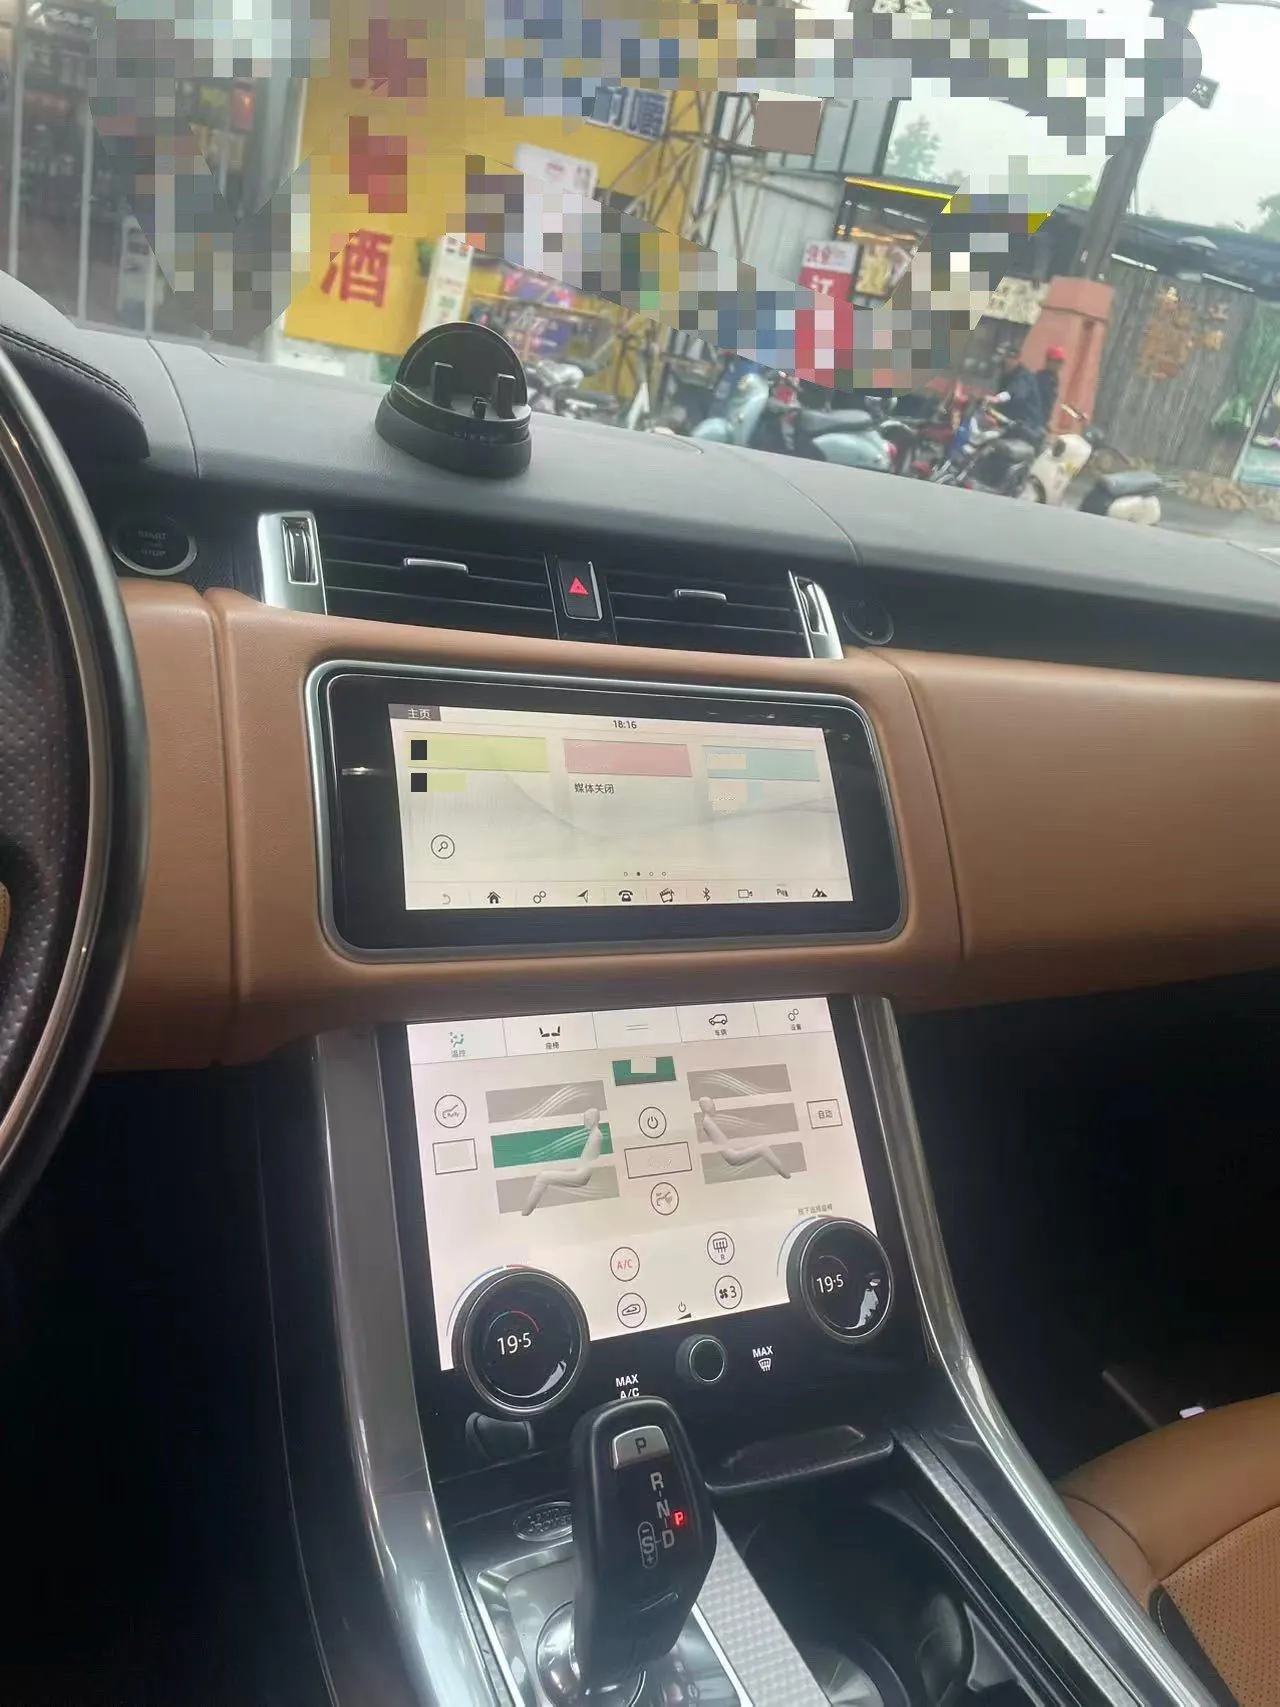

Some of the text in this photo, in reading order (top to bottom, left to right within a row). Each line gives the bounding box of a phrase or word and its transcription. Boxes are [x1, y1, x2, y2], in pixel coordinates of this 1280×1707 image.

[320, 229, 393, 308] 酒
[407, 707, 432, 720] 主页
[613, 720, 637, 729] 18:16
[574, 782, 615, 794] 媒体关闭
[818, 1109, 833, 1119] 自动
[616, 1259, 633, 1270] A/C
[729, 1285, 737, 1299] 3
[752, 1345, 774, 1358] MAX
[615, 1374, 639, 1387] MAX
[620, 1388, 640, 1400] A/C
[635, 1436, 647, 1454] P
[650, 1471, 664, 1491] R
[656, 1499, 670, 1519] N
[674, 1511, 684, 1526] P
[641, 1536, 655, 1554] S
[661, 1529, 675, 1549] D
